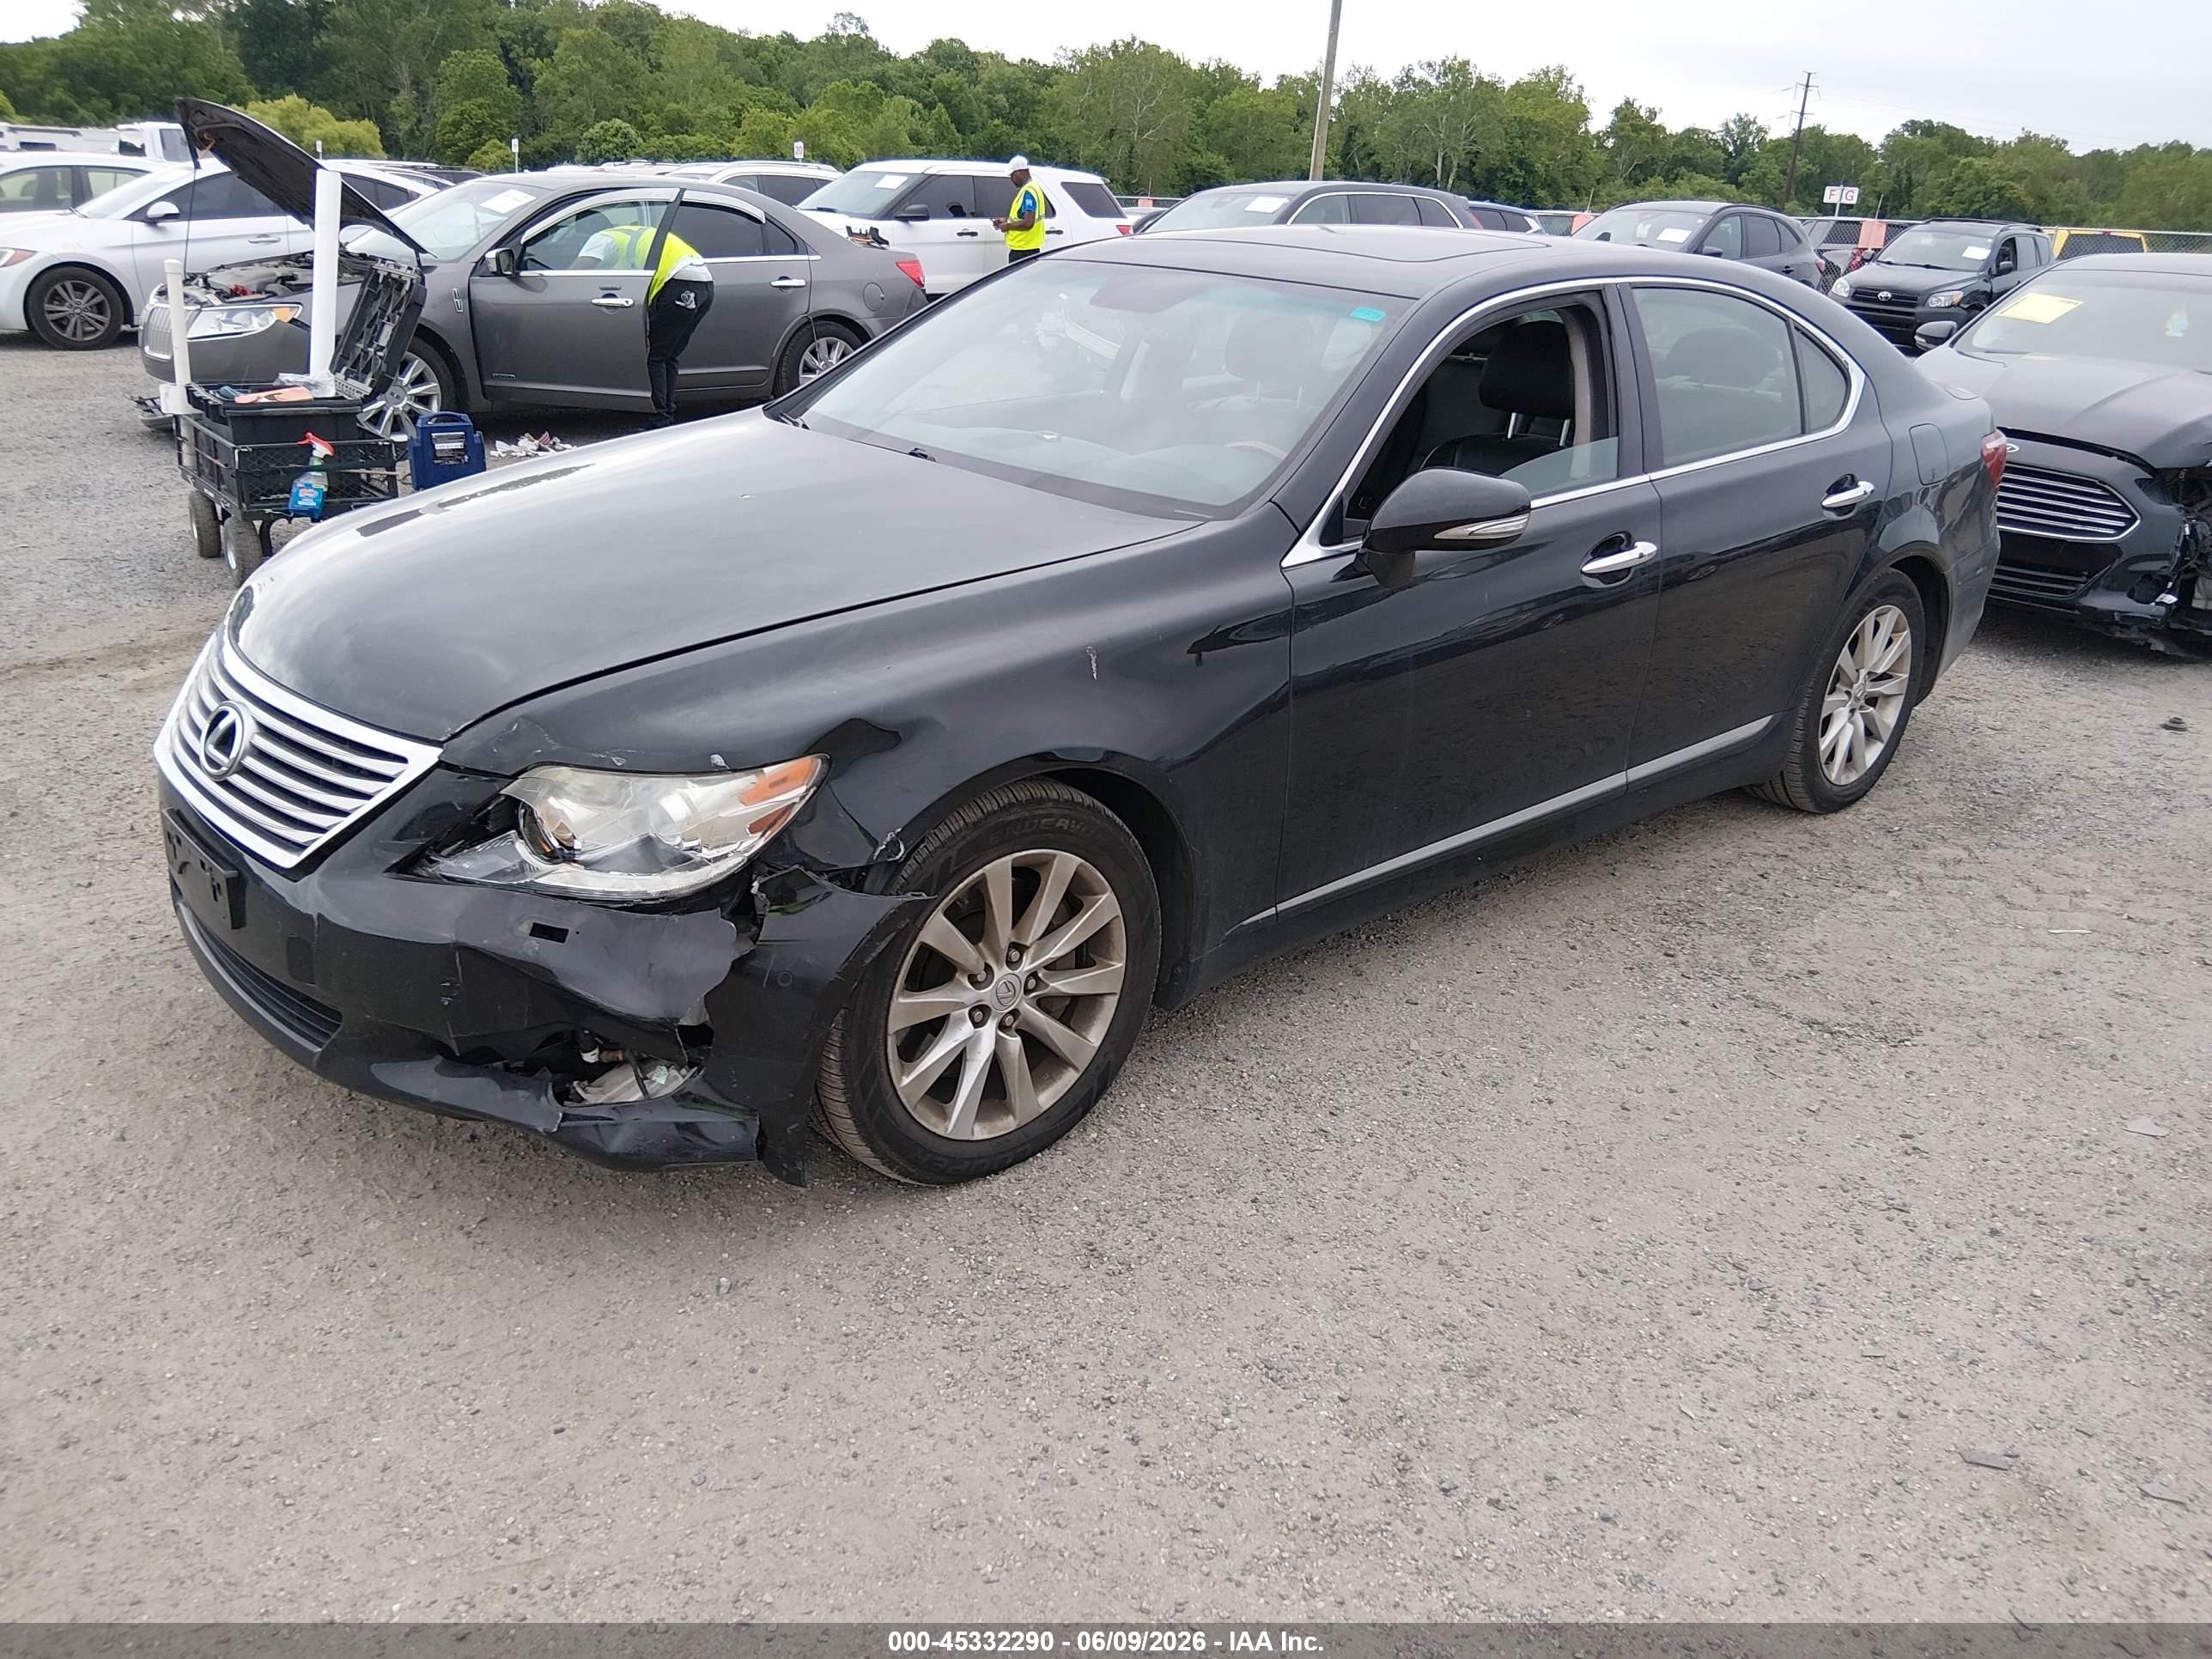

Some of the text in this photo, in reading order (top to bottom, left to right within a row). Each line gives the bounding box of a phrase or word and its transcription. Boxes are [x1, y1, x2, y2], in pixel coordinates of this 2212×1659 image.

[1828, 189, 1837, 200] F
[1844, 190, 1855, 201] G
[988, 817, 1108, 845] ENDEAVO
